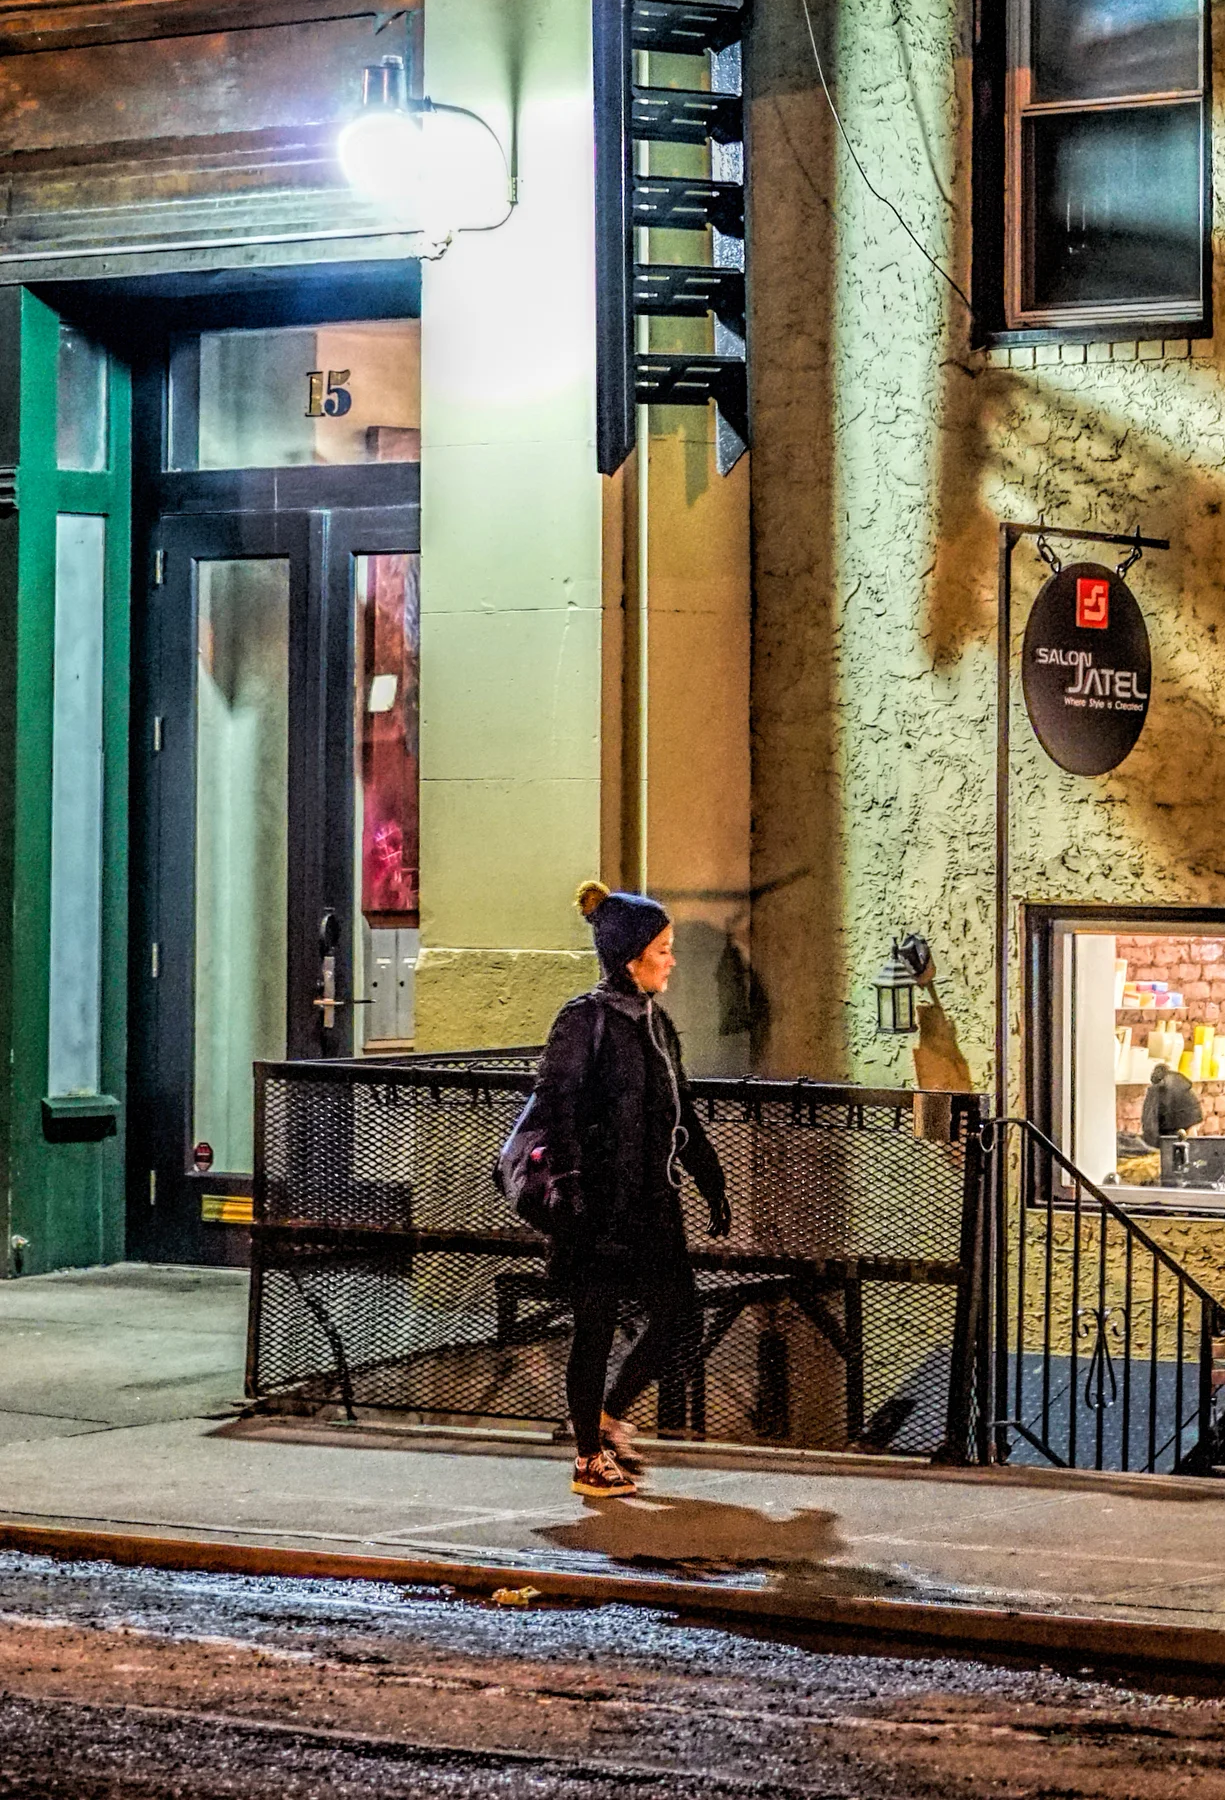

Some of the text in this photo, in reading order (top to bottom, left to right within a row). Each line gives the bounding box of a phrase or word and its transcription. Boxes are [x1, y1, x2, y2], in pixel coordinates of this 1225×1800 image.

[305, 369, 352, 417] 15
[1036, 647, 1092, 667] SALON
[1066, 656, 1147, 699] JATEL
[1064, 696, 1086, 707] Where
[1089, 698, 1105, 709] Style
[1115, 700, 1144, 711] Created
